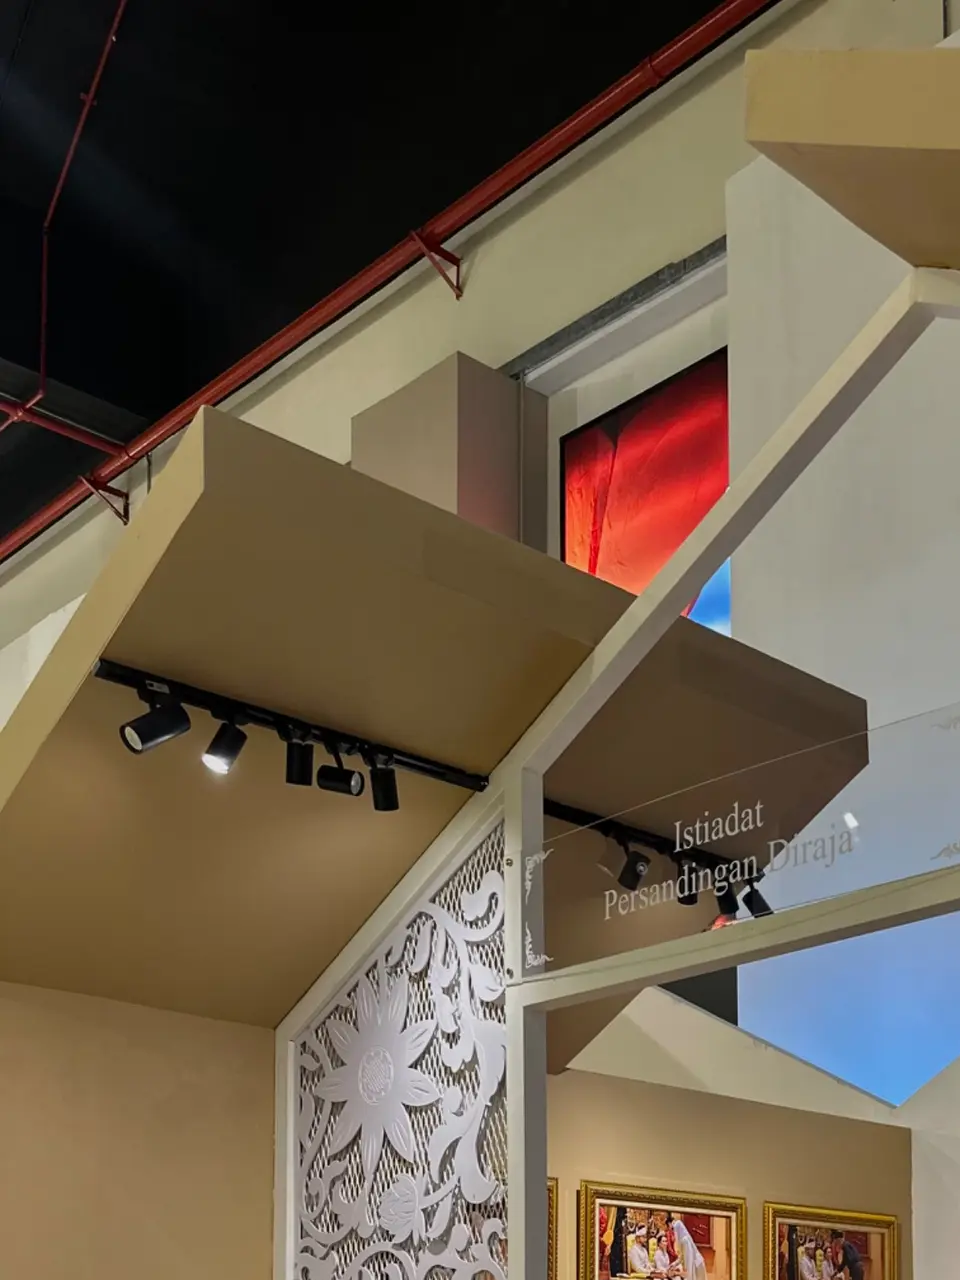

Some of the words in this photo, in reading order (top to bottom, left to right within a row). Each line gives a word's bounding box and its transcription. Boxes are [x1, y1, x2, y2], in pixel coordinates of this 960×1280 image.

[673, 801, 764, 854] Istiadat
[603, 855, 758, 921] Persandingan
[767, 823, 854, 873] Diraja
